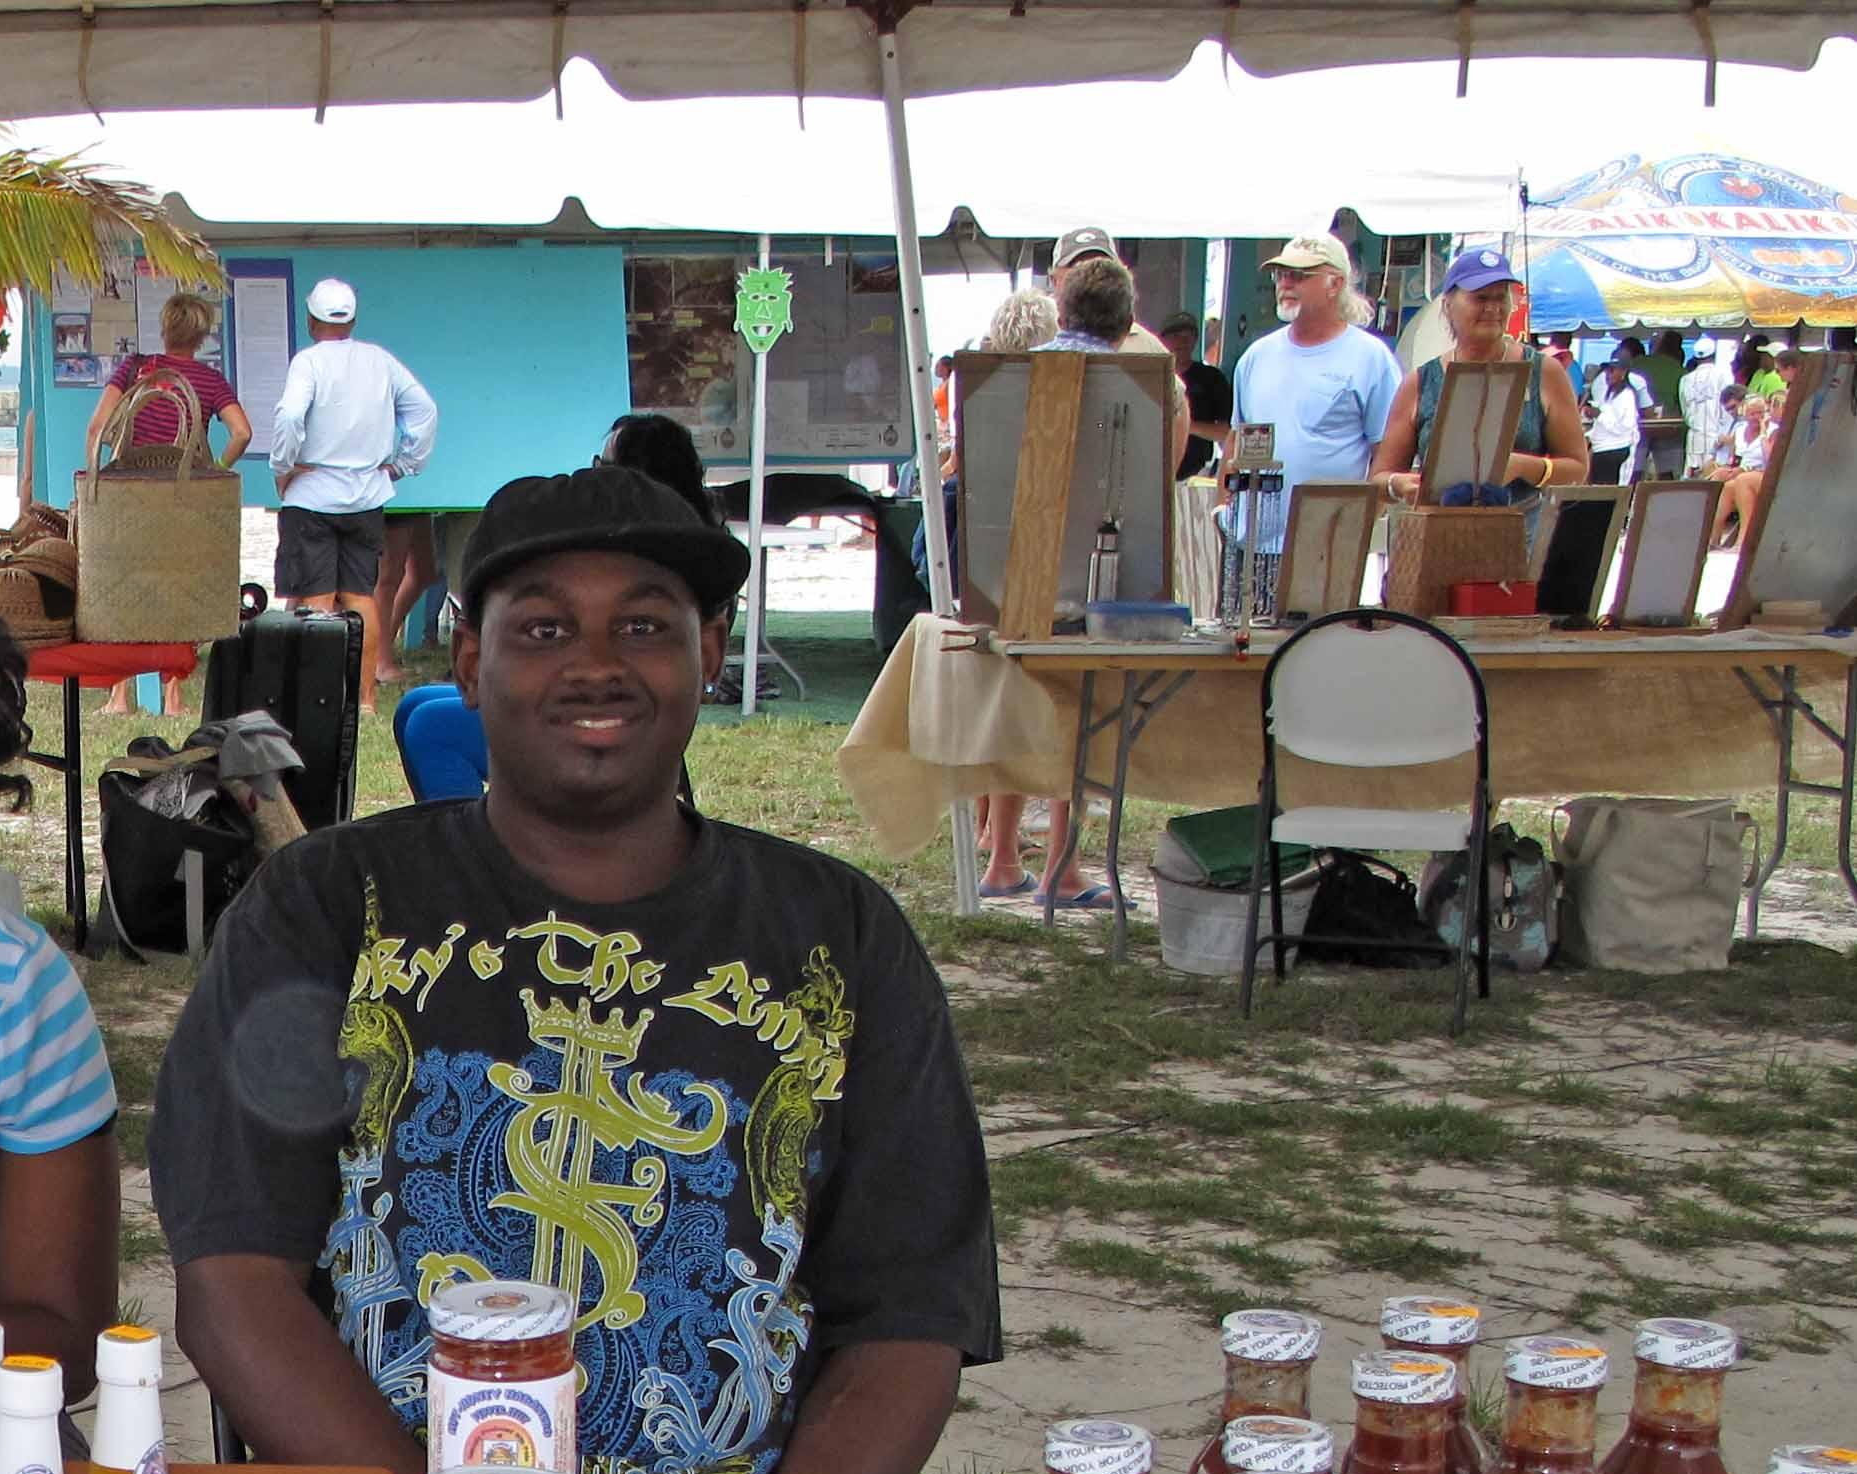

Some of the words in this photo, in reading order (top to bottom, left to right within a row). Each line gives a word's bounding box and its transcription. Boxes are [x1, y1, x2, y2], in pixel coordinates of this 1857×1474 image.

[1702, 211, 1833, 233] KALIK
[348, 925, 506, 1012] ky's
[508, 911, 667, 1003] The
